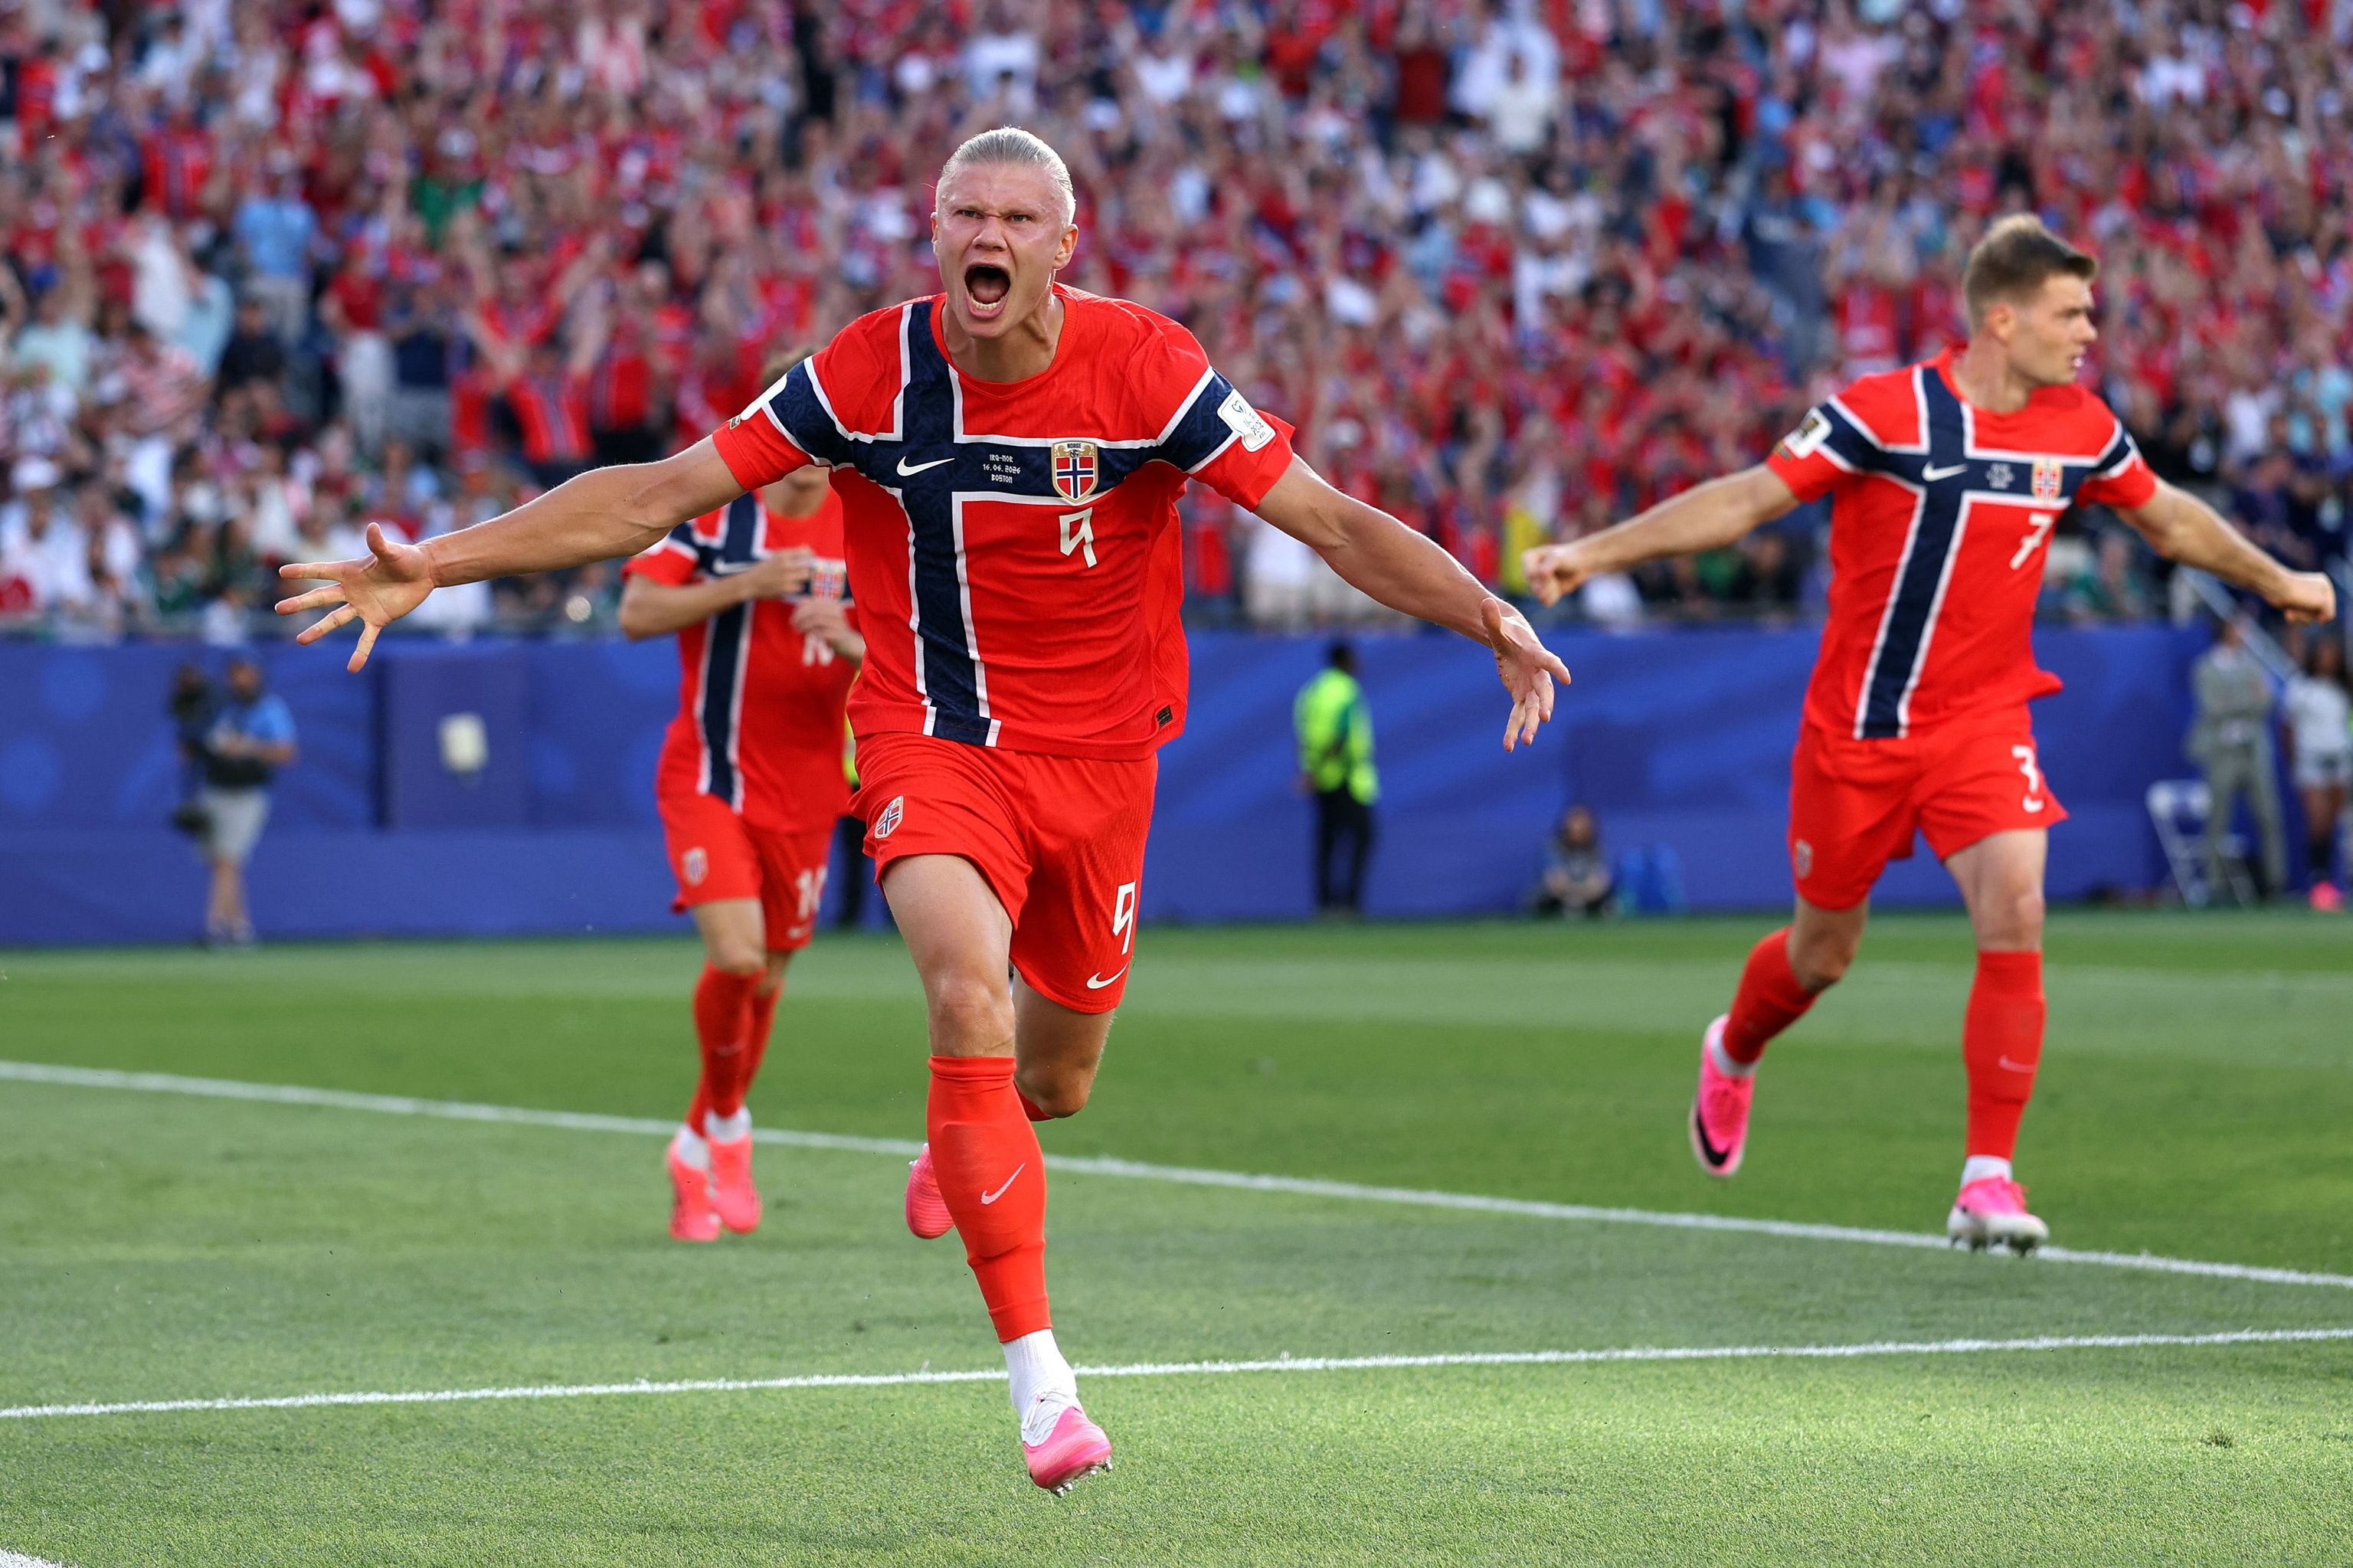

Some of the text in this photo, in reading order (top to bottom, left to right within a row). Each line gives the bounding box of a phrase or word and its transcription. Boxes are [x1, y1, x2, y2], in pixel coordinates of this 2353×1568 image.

[982, 463, 1021, 474] 16.06.2026
[989, 453, 1014, 463] IRQ-NOR
[990, 473, 1013, 484] BOSTON
[1059, 506, 1098, 568] 9
[2009, 512, 2054, 570] 7
[1113, 879, 1137, 956] 9
